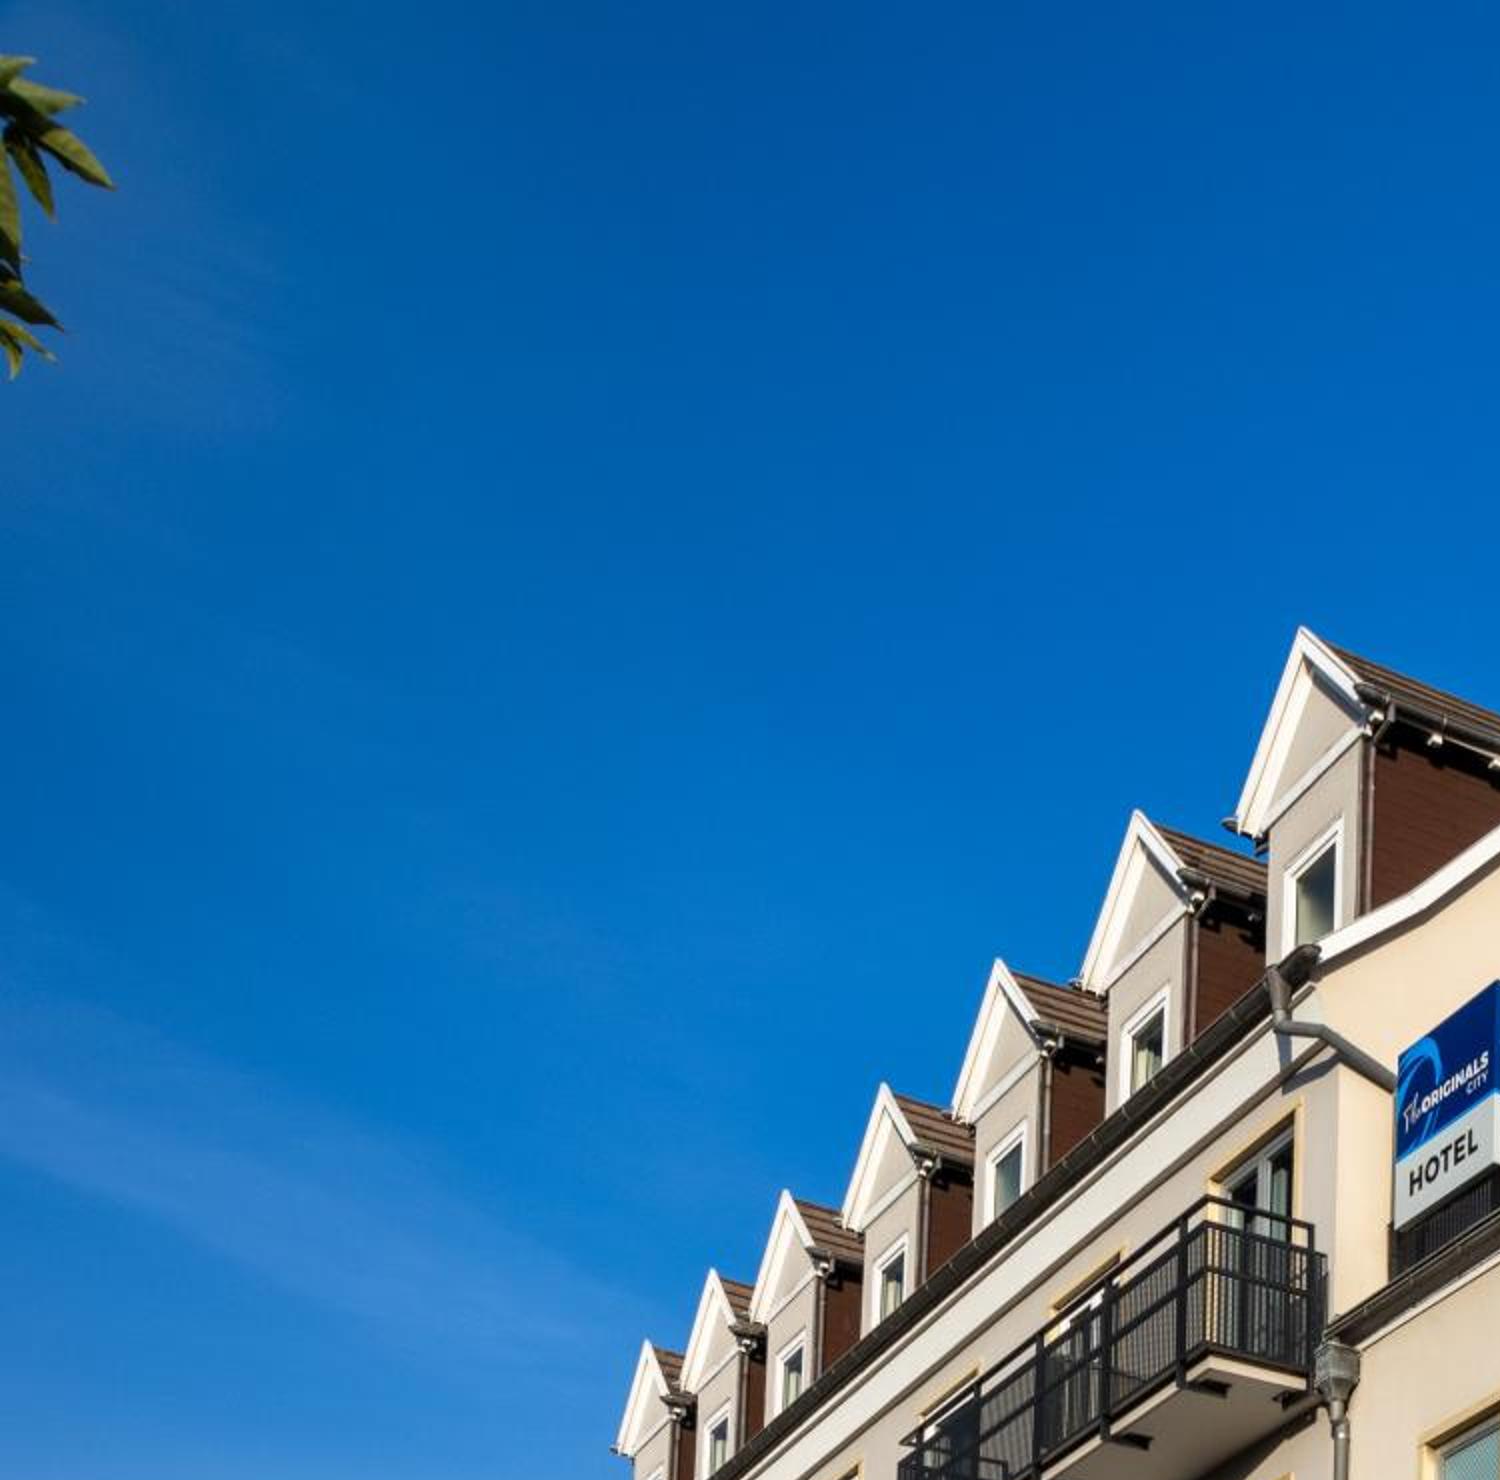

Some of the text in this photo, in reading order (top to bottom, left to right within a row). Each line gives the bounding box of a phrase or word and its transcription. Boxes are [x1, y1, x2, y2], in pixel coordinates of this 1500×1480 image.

[1421, 1050, 1490, 1113] ORIGINALS
[1465, 1068, 1489, 1095] CITY
[1409, 1128, 1479, 1197] HOTEL
